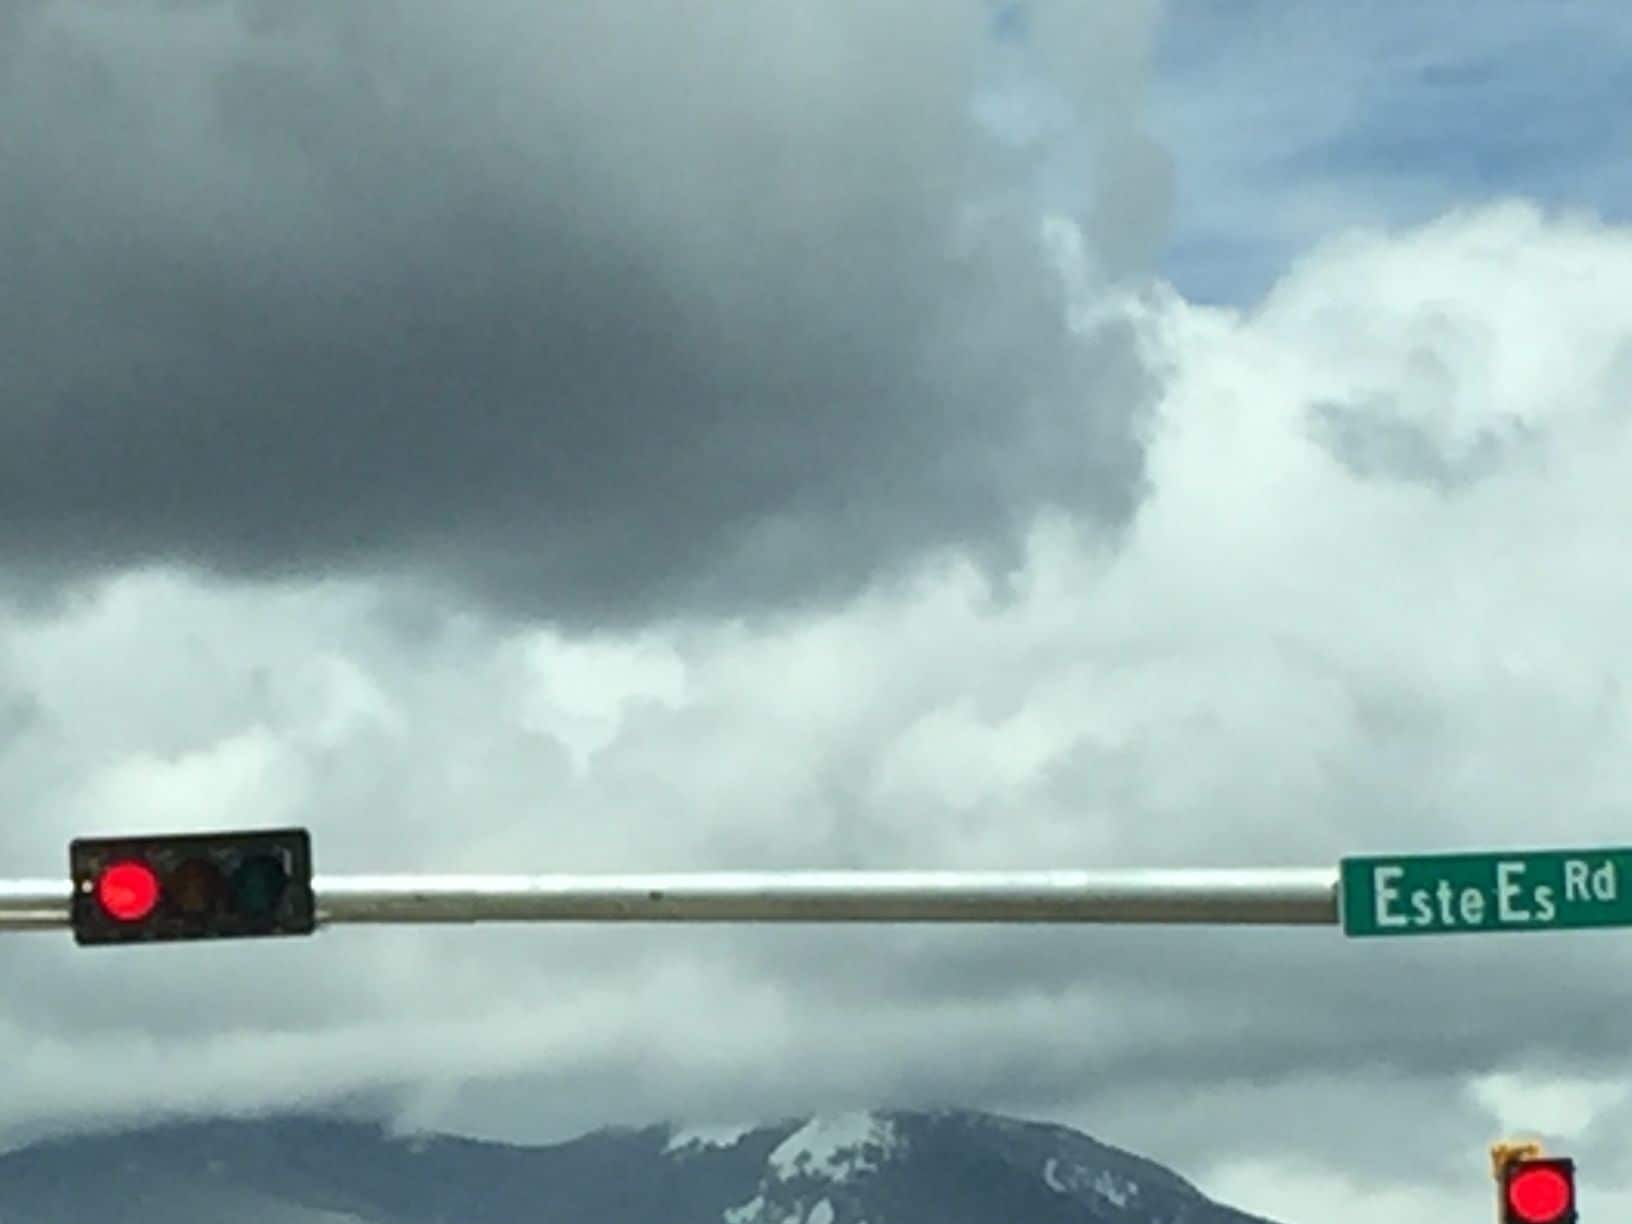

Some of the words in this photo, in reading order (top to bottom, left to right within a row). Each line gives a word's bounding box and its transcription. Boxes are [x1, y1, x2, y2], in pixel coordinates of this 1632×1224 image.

[1373, 866, 1485, 927] Este
[1496, 861, 1556, 922] Es
[1564, 859, 1617, 902] Rd
